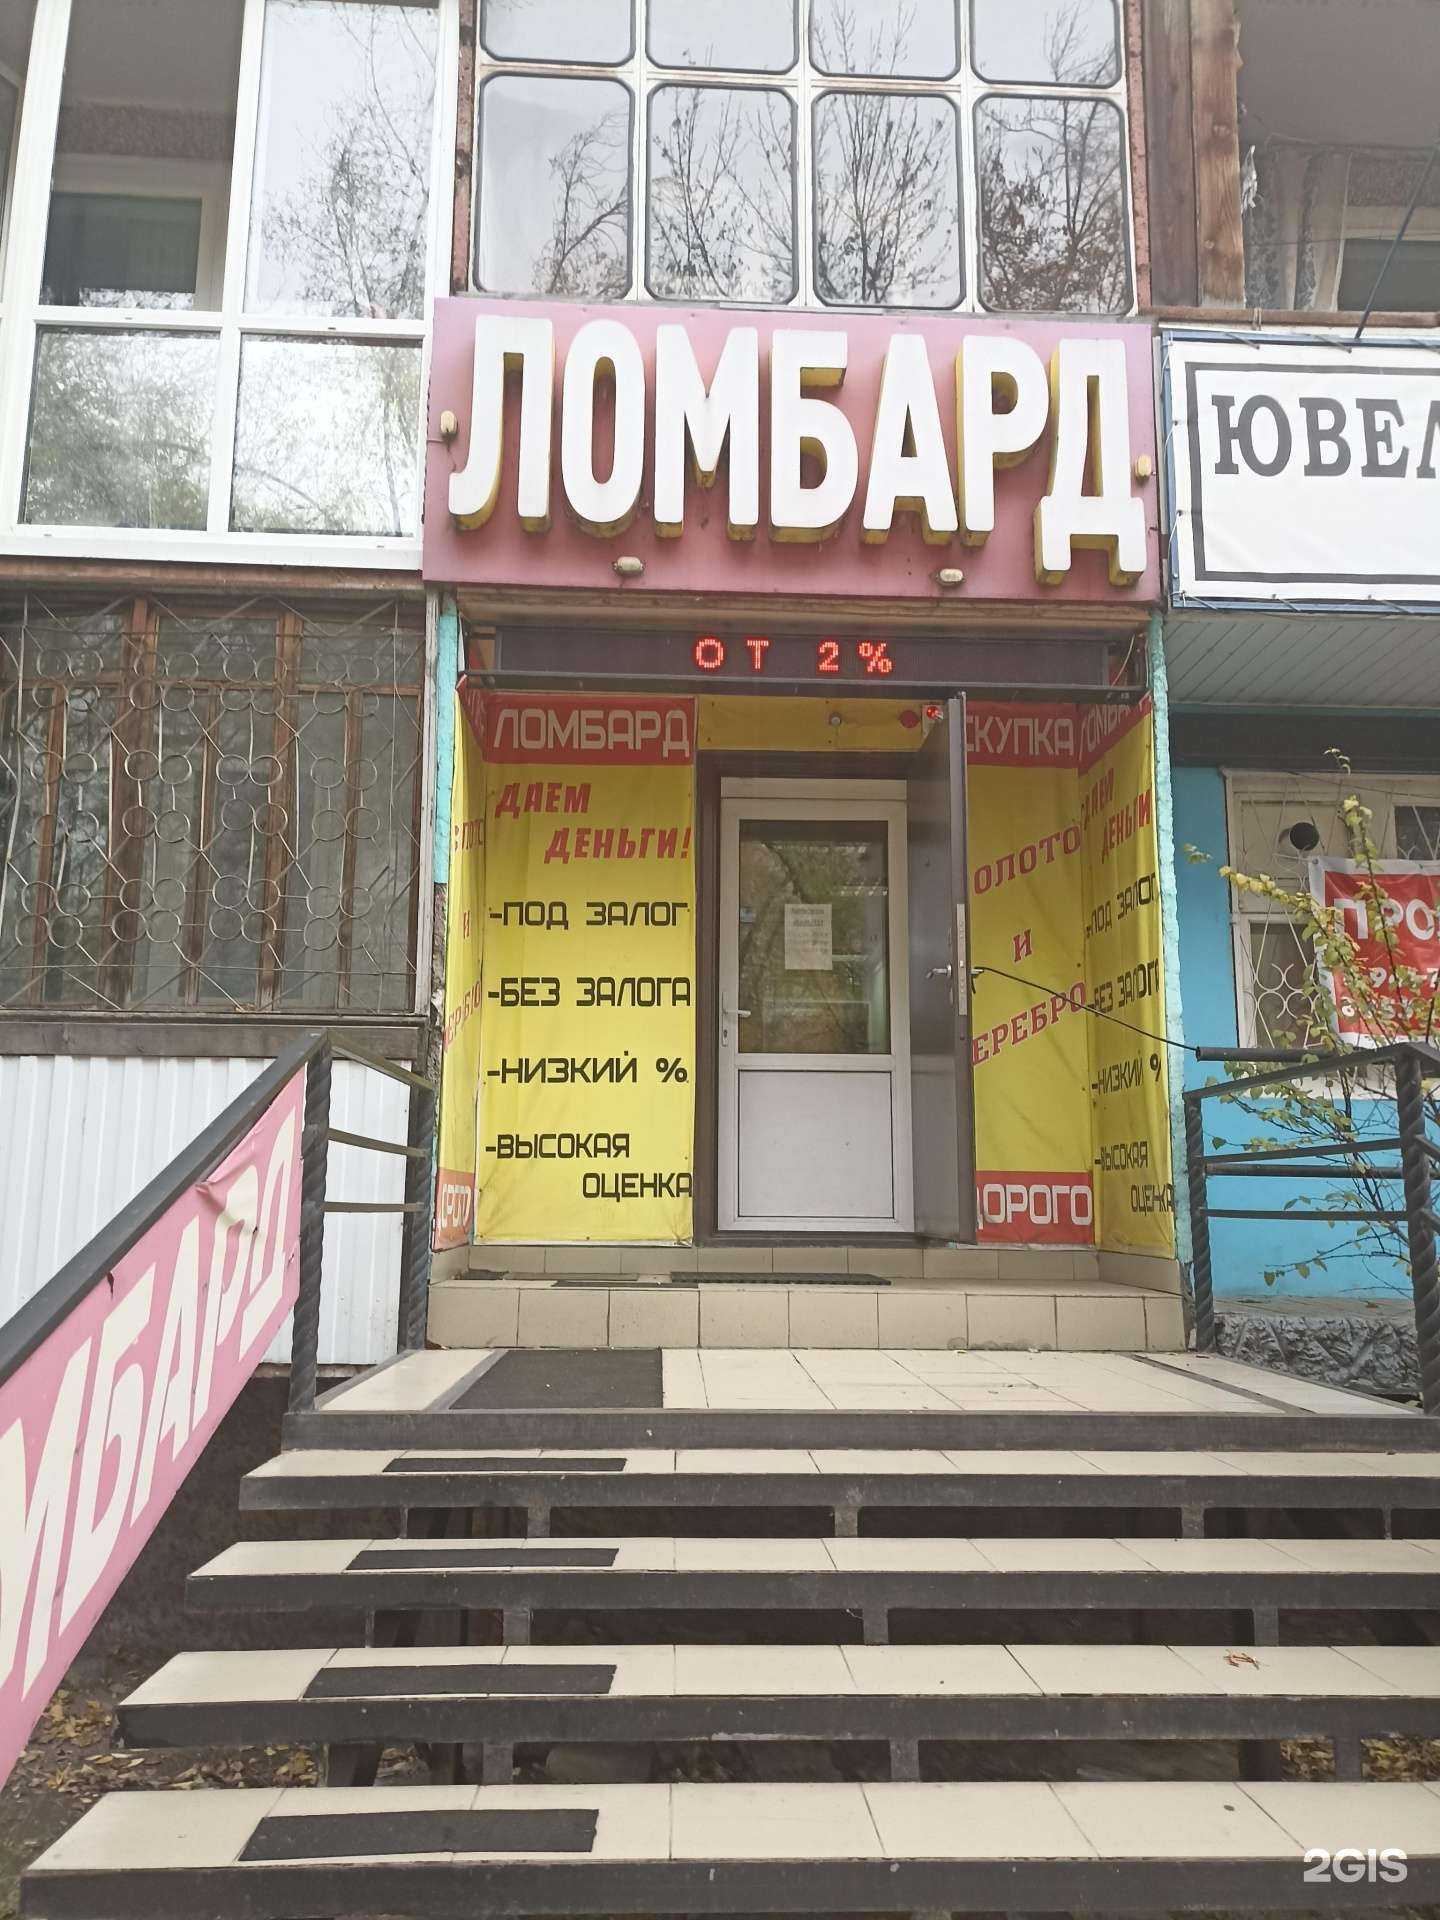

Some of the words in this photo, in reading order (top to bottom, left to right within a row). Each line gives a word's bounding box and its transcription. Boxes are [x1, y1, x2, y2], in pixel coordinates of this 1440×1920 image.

[449, 315, 1146, 585] ЛОМБАРД
[493, 708, 690, 758] ЛОМБАРД
[494, 781, 592, 819] ДАЕМ
[543, 825, 692, 865] ДЕНЬГИ!
[974, 824, 1082, 895] ОЛОТО
[489, 900, 569, 930] -ПОД
[585, 900, 688, 927] ЗАЛОГ
[1333, 897, 1440, 941] ПРО
[1013, 928, 1033, 963] И
[487, 976, 561, 1007] -БЕЗ
[575, 976, 691, 1007] ЗАЛОГА
[972, 980, 1087, 1067] ЕРЕБРО
[486, 1050, 638, 1084] -НИЗКИЙ
[655, 1056, 688, 1083] %
[485, 1133, 630, 1159] -ВЫСОКАЯ
[582, 1172, 693, 1203] ОЦЕНКА
